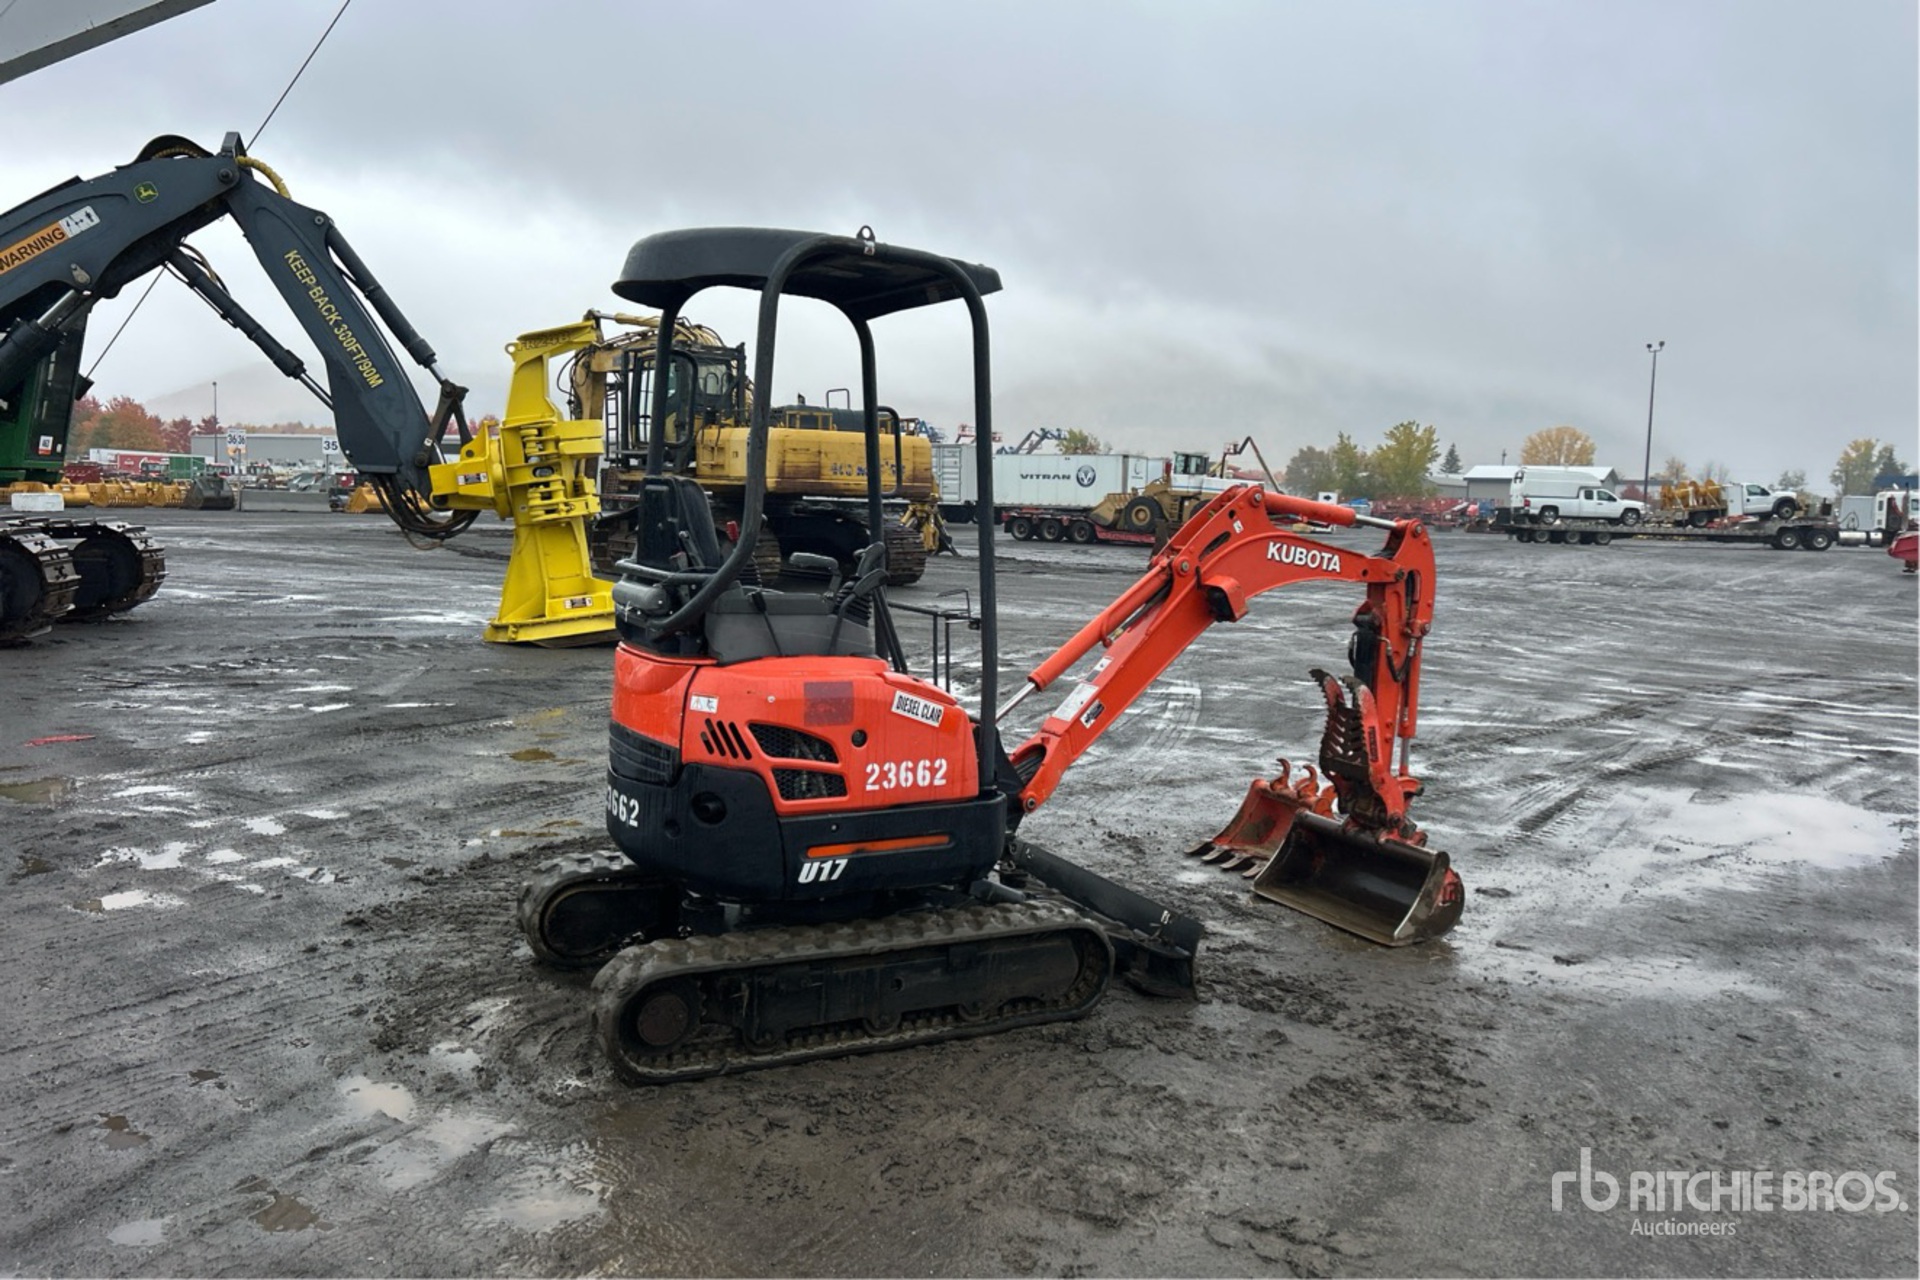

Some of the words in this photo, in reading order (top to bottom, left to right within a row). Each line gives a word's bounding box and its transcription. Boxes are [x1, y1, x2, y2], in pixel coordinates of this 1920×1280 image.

[0, 227, 66, 270] WARNING
[284, 250, 317, 288] KEEP
[308, 286, 342, 326] BACK
[334, 323, 384, 388] 300FT/90M
[323, 440, 338, 451] 35
[1020, 473, 1071, 481] VITRAN
[1266, 541, 1341, 573] KUBOTA
[896, 695, 921, 717] DIESEL
[920, 703, 942, 723] CLAIR
[865, 758, 948, 791] 23662
[798, 858, 848, 884] U17
